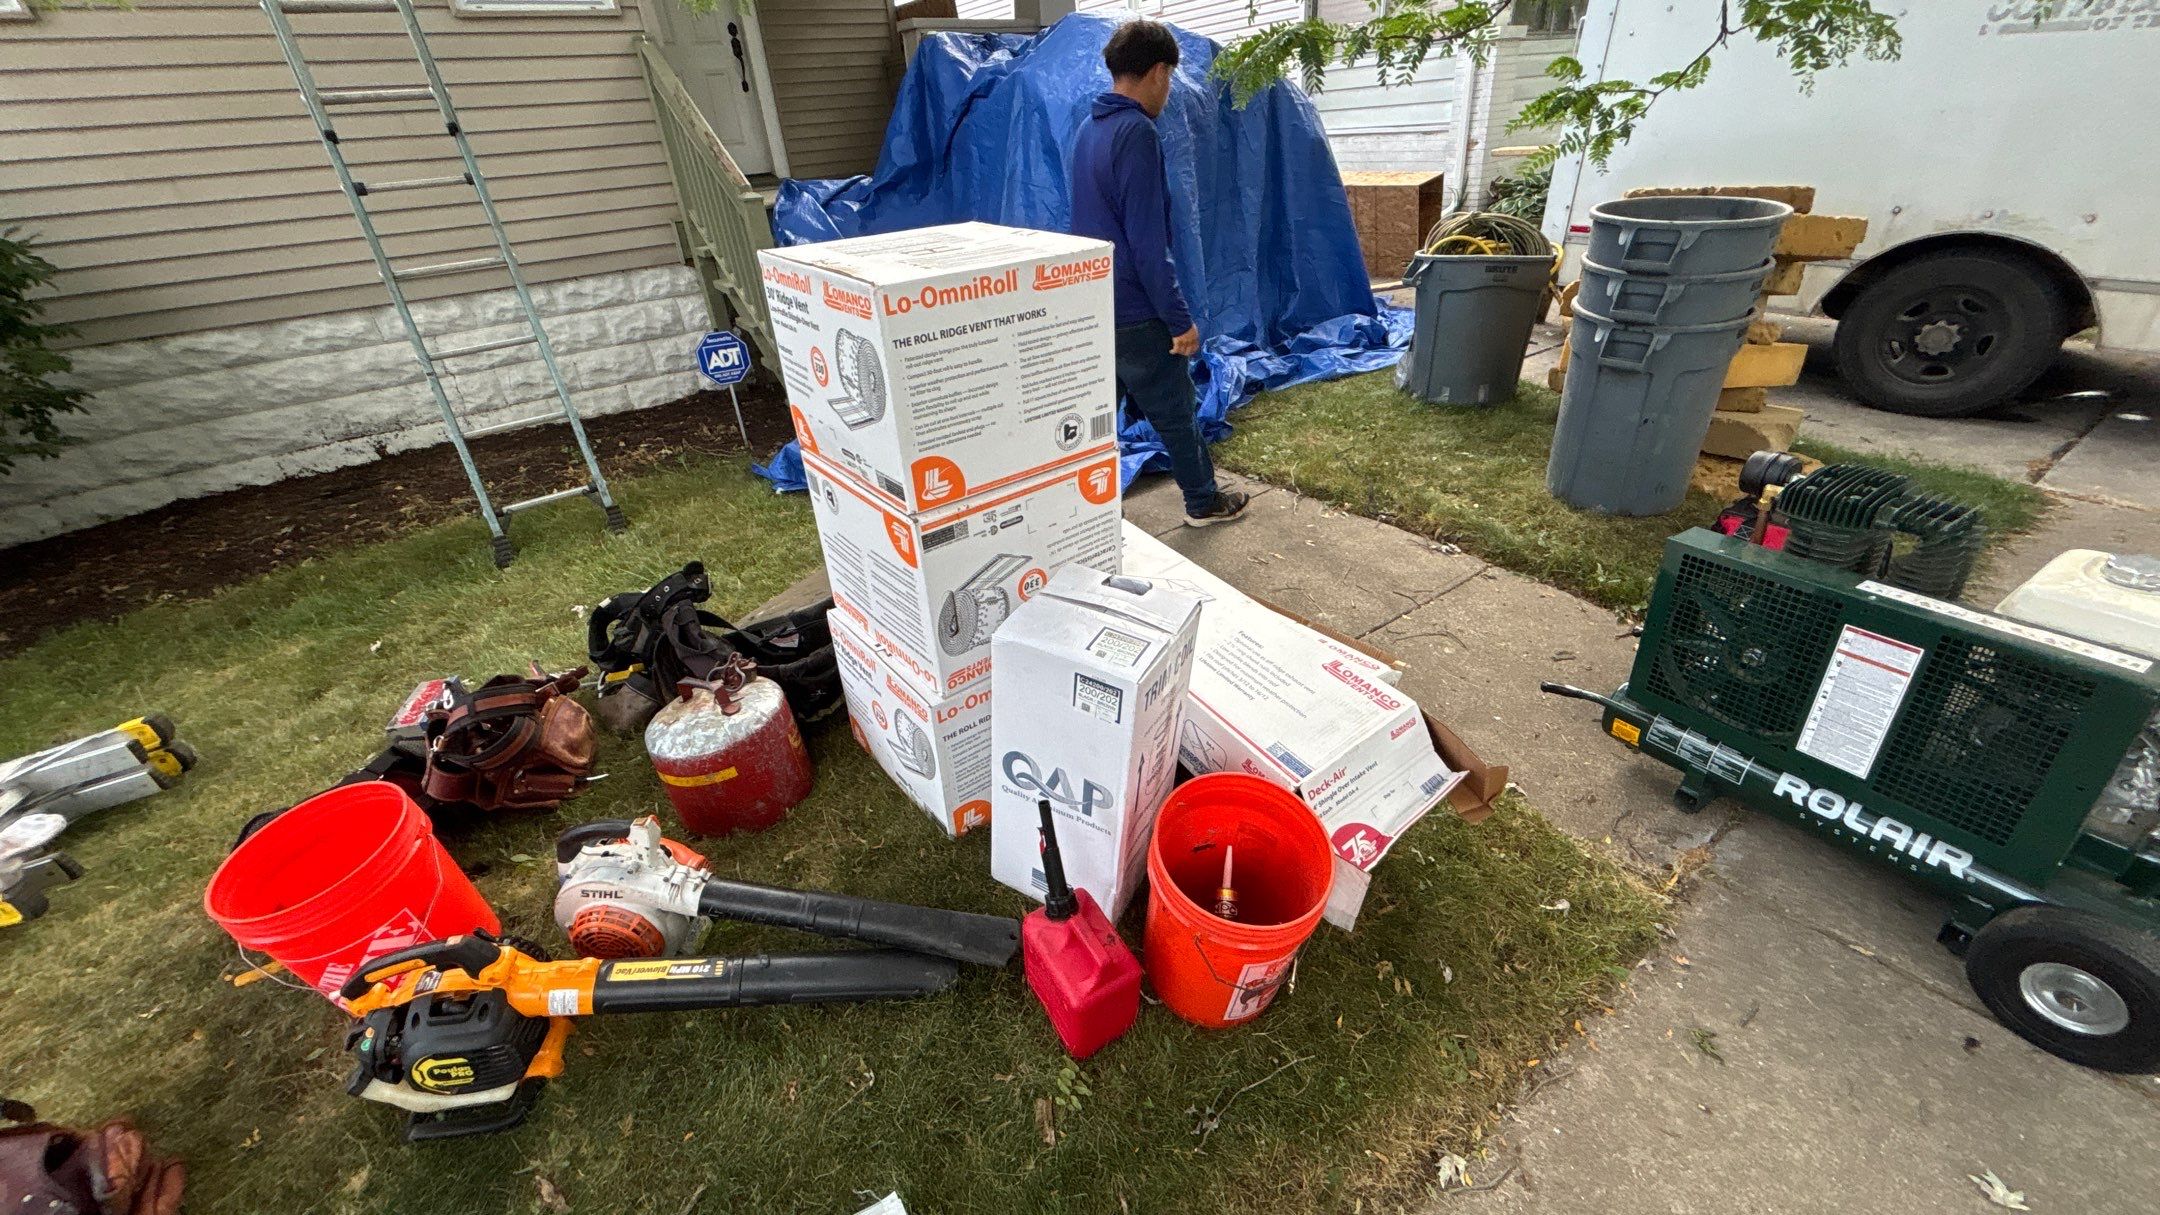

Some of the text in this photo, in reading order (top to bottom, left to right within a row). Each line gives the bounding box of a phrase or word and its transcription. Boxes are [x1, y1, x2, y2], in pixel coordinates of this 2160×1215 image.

[761, 264, 812, 295] Lo-OmniRoll
[1035, 256, 1110, 280] LOMANCO
[1062, 274, 1092, 286] VENTS
[776, 289, 793, 309] Ridge
[792, 296, 809, 314] Vent
[823, 281, 871, 310] LOMANCO
[883, 268, 1016, 316] Lo-OmniRoll
[893, 337, 912, 349] THE
[914, 332, 938, 346] ROLL
[940, 325, 968, 340] RIDGE
[969, 319, 992, 333] VENT
[994, 314, 1016, 327] THAT
[1016, 308, 1046, 322] WORKS
[709, 348, 740, 370] ADT
[1024, 578, 1040, 590] 330
[1238, 631, 1264, 648] Features:
[876, 629, 937, 691] Lo-OmniRoll
[948, 664, 992, 690] MANCO
[1144, 663, 1172, 712] TRIM
[1328, 660, 1400, 708] LOMANCO
[1346, 681, 1374, 700] VENTS
[937, 692, 992, 724] Lo-Om
[1079, 684, 1118, 706] 200/202
[942, 714, 992, 742] THE ROLL RID
[1002, 751, 1114, 817] QAP
[1308, 768, 1346, 800] Deck-Air
[1318, 790, 1338, 808] Shingle
[1337, 780, 1350, 793] Over
[1350, 770, 1369, 784] Intake
[1365, 760, 1378, 774] Vent
[1002, 784, 1112, 836] Quality Ainum Products
[1773, 772, 1973, 879] ROLAIR
[1800, 812, 1918, 871] SYSTEMS
[581, 890, 624, 899] STIHL
[615, 965, 668, 976] Blower/Vac
[432, 1066, 472, 1075] Poulan
[450, 1070, 474, 1078] PRO
